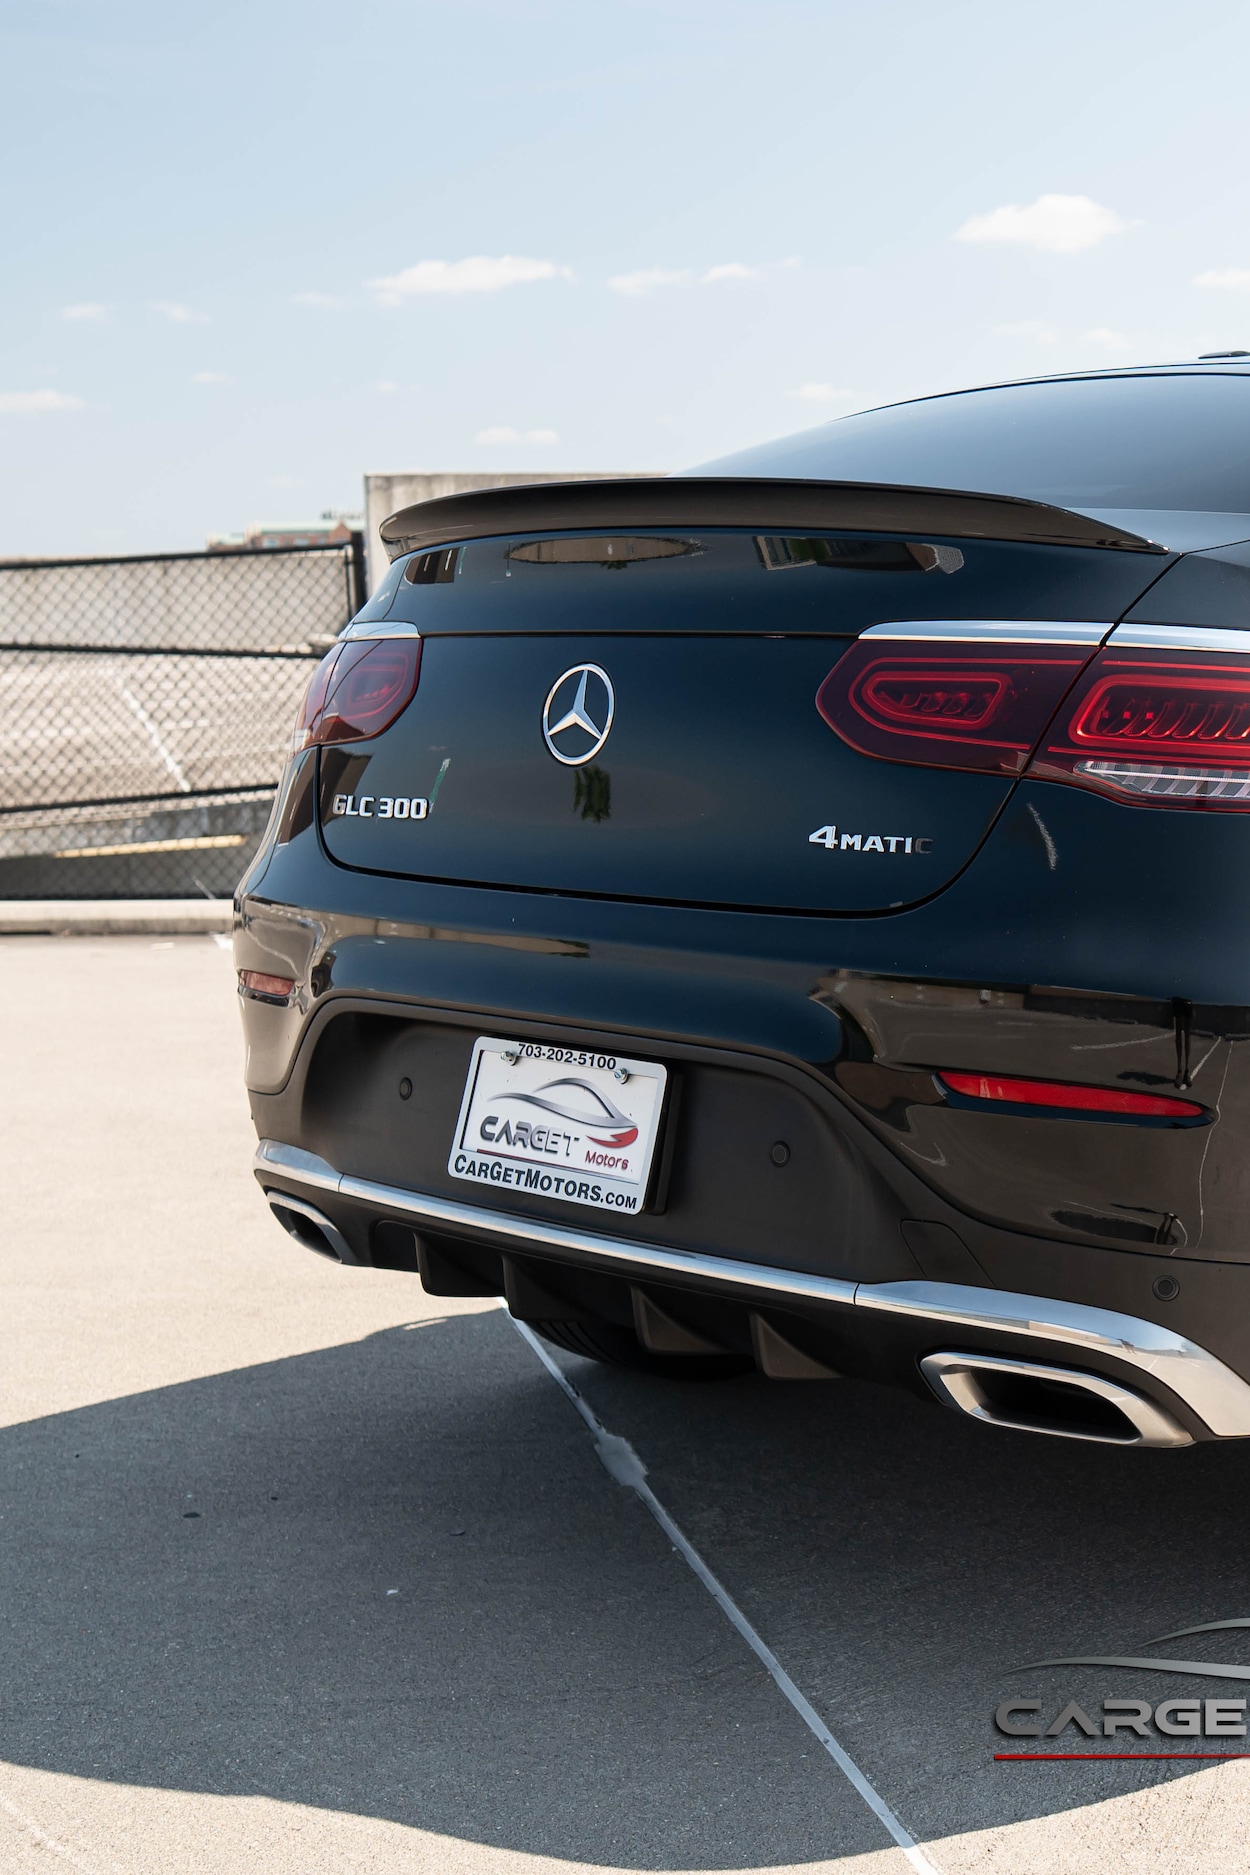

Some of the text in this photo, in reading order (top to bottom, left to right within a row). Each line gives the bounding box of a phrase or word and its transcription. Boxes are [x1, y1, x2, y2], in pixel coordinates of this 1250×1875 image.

[333, 794, 428, 819] GLC 300
[808, 825, 933, 854] 4MATIC
[518, 1043, 616, 1070] 703-202-5100
[480, 1115, 629, 1171] CARGET Motors
